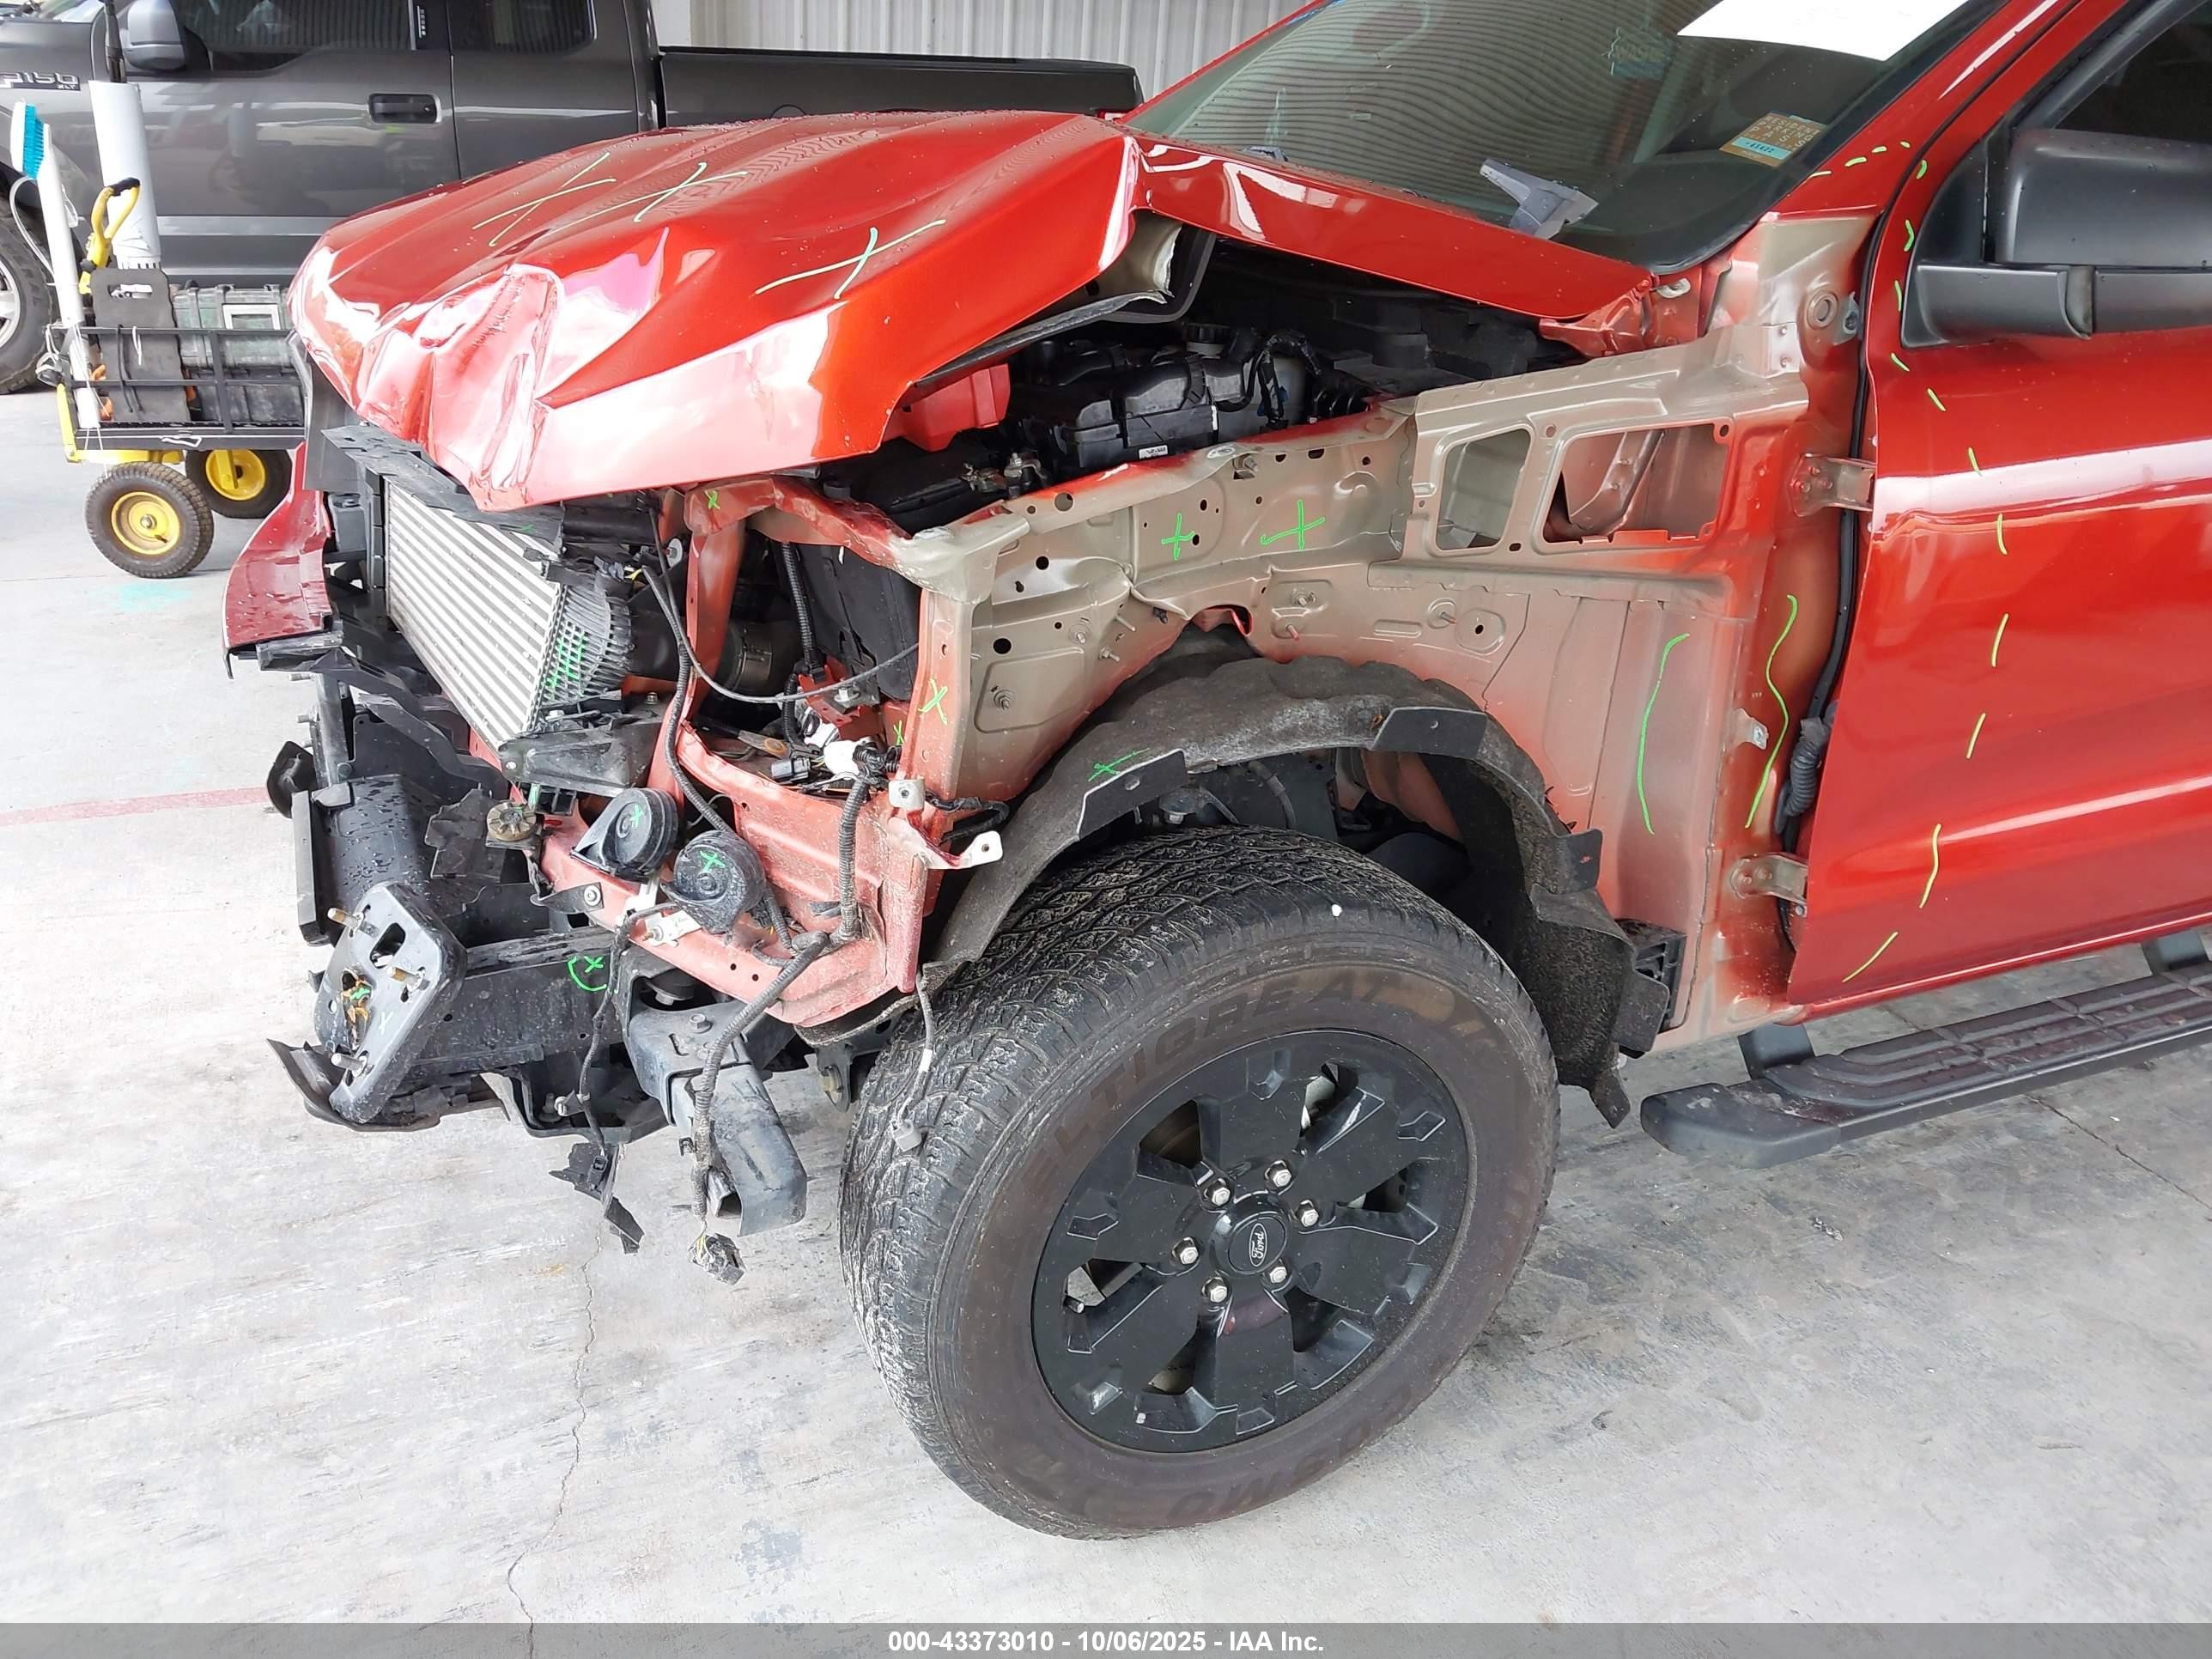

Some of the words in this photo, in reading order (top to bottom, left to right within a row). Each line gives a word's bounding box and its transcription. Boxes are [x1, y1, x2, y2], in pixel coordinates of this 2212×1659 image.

[1757, 121, 1814, 142] PARKING
[1764, 115, 1820, 136] RESIDENT
[1086, 975, 1299, 1115] TIGRE
[1251, 1231, 1265, 1259] Ford
